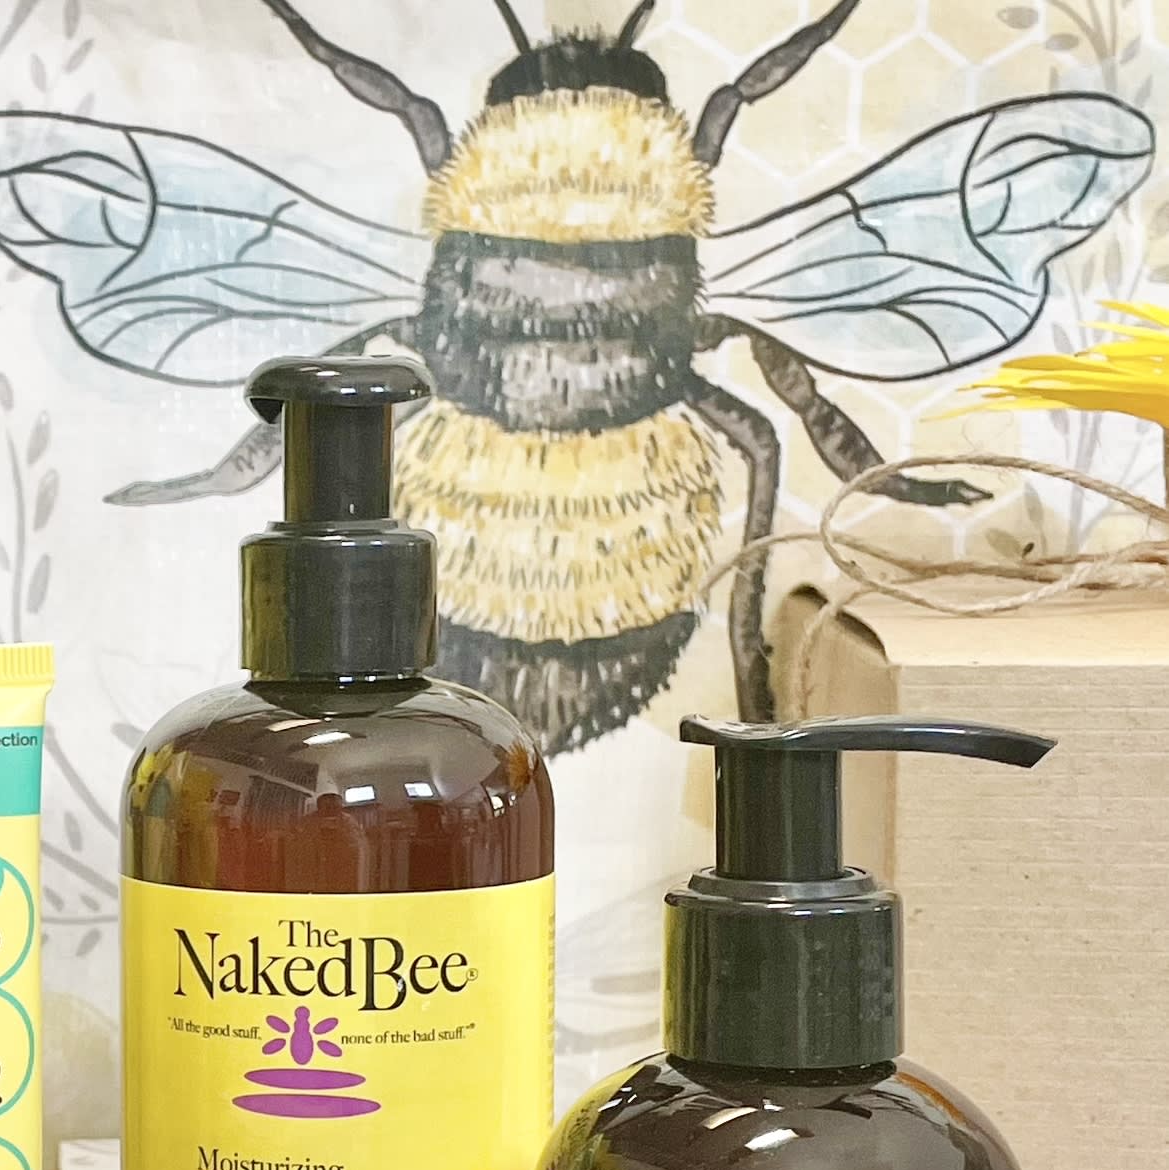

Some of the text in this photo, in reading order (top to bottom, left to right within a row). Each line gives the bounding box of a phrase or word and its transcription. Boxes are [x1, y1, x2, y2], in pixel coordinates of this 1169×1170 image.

[278, 919, 341, 949] The
[185, 1020, 201, 1034] the
[202, 1022, 230, 1039] good
[341, 1035, 372, 1045] none
[375, 1030, 391, 1044] of
[391, 1029, 411, 1043] the
[413, 1029, 436, 1042] bad
